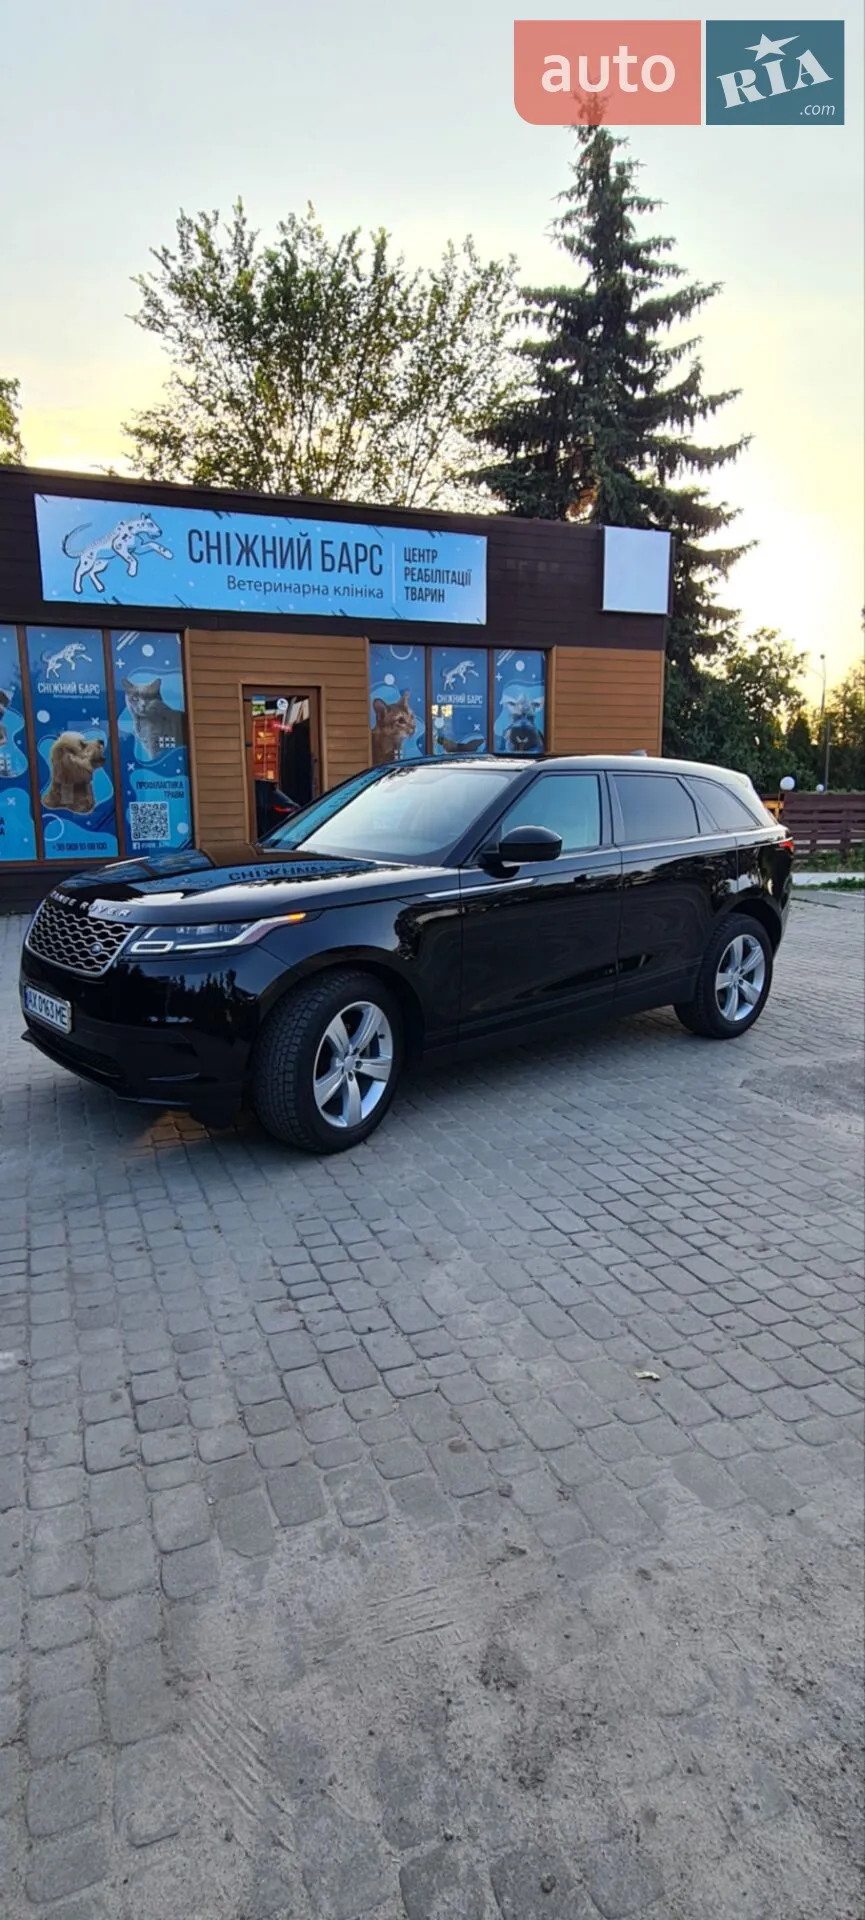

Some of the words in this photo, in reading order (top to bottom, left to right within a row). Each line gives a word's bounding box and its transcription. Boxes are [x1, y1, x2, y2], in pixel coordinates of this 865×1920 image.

[187, 528, 312, 572] СНІЖНИЙ
[320, 539, 384, 577] БАРС
[403, 546, 438, 564] ЦЕНТР
[403, 566, 473, 587] РЕАБІЛІТАЦІЇ
[226, 575, 330, 597] Ветеринарна
[333, 584, 384, 600] клініка
[403, 586, 446, 603] ТВАРИН
[78, 683, 100, 695] БАРС
[79, 901, 132, 917] ROVER
